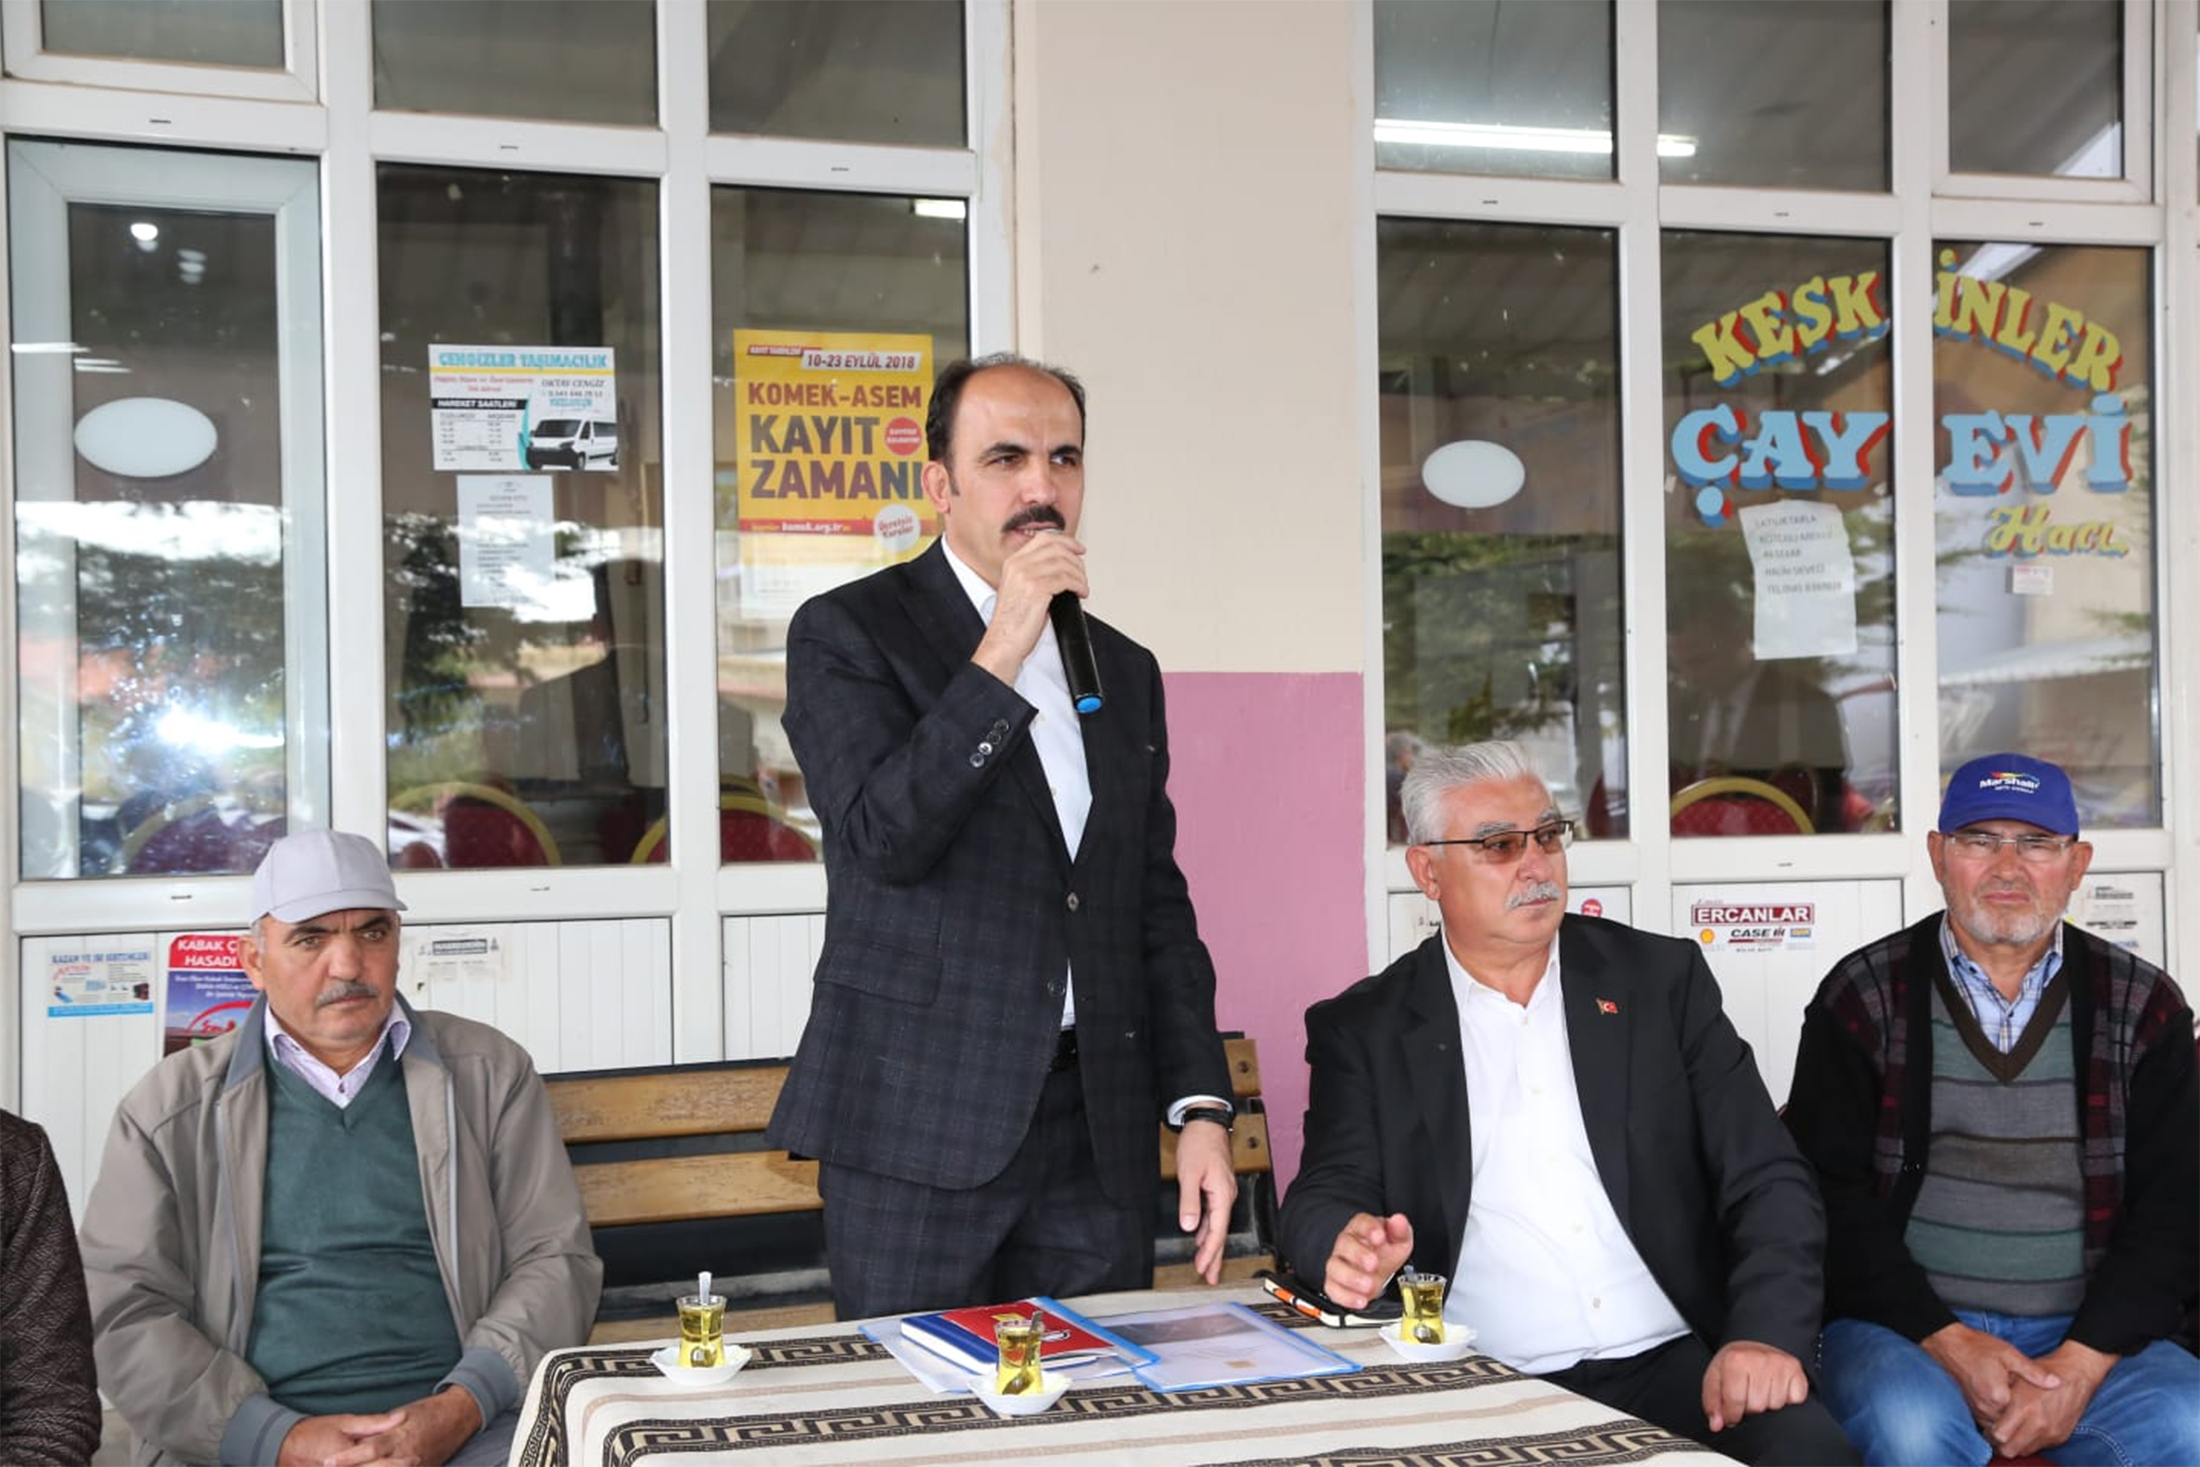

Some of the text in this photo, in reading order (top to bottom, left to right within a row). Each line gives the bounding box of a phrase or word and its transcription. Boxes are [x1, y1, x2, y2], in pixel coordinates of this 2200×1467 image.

[1932, 248, 2122, 393] İNLER
[807, 353, 915, 369] 10-23 EYLÜL 2018
[748, 382, 922, 408] KOMEK-ASEM
[750, 414, 880, 455] KAYIT
[1671, 393, 2134, 528] ÇAY EVİ
[752, 460, 923, 500] ZAMANI
[1697, 907, 1809, 923] ERCANLAR
[1730, 928, 1771, 938] CASE
[177, 939, 224, 951] KABAK
[184, 955, 238, 967] HASADI
